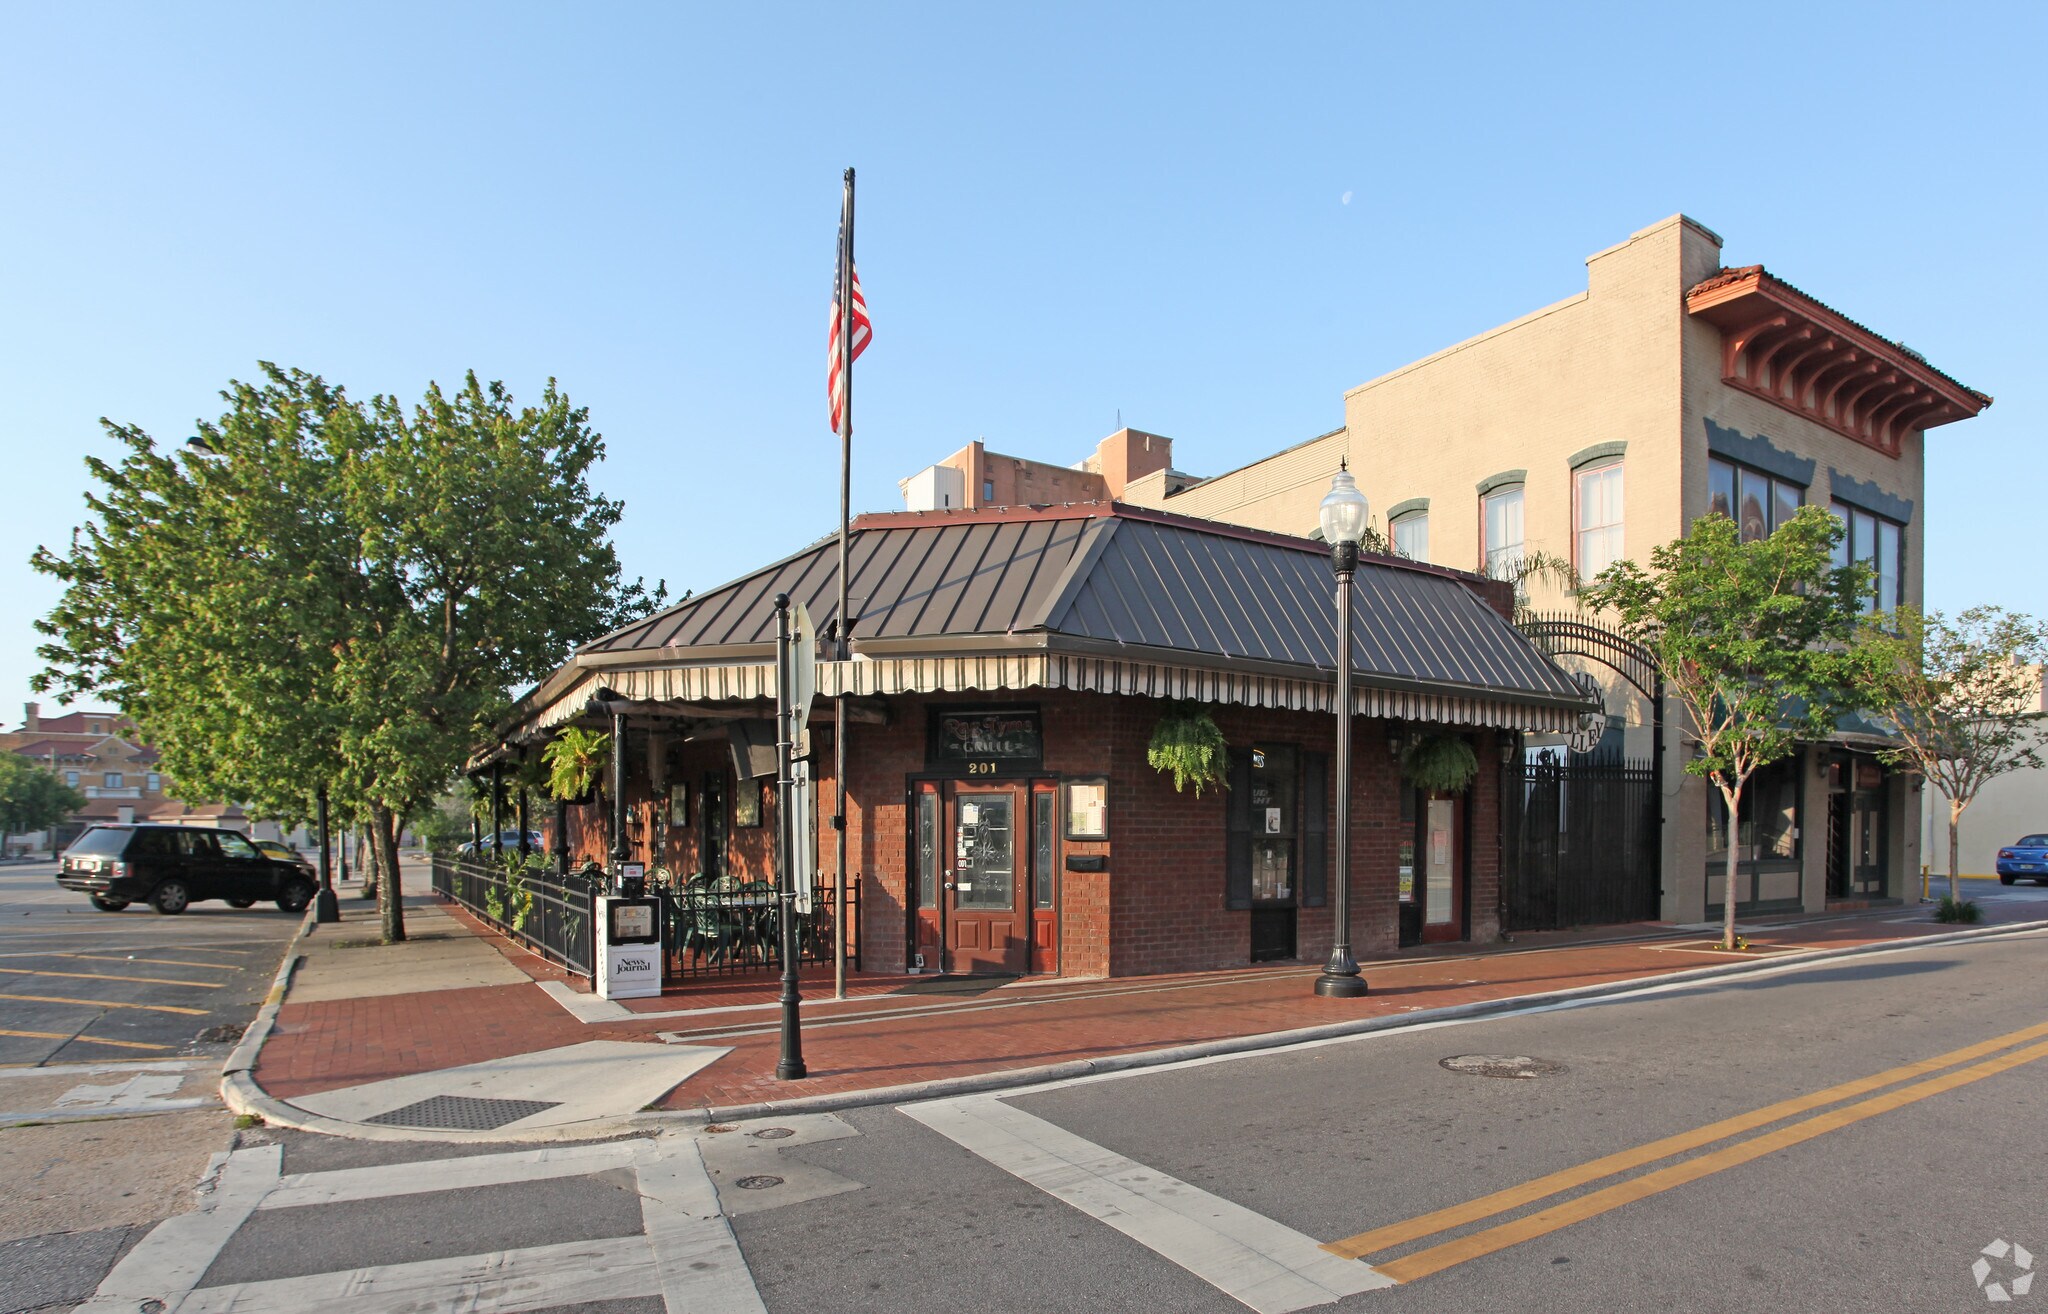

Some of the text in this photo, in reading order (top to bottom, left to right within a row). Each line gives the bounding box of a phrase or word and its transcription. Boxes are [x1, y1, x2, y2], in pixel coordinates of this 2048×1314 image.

[1570, 721, 1603, 752] LLEY
[969, 762, 996, 774] 201
[616, 962, 651, 974] Journal
[621, 958, 646, 967] News
